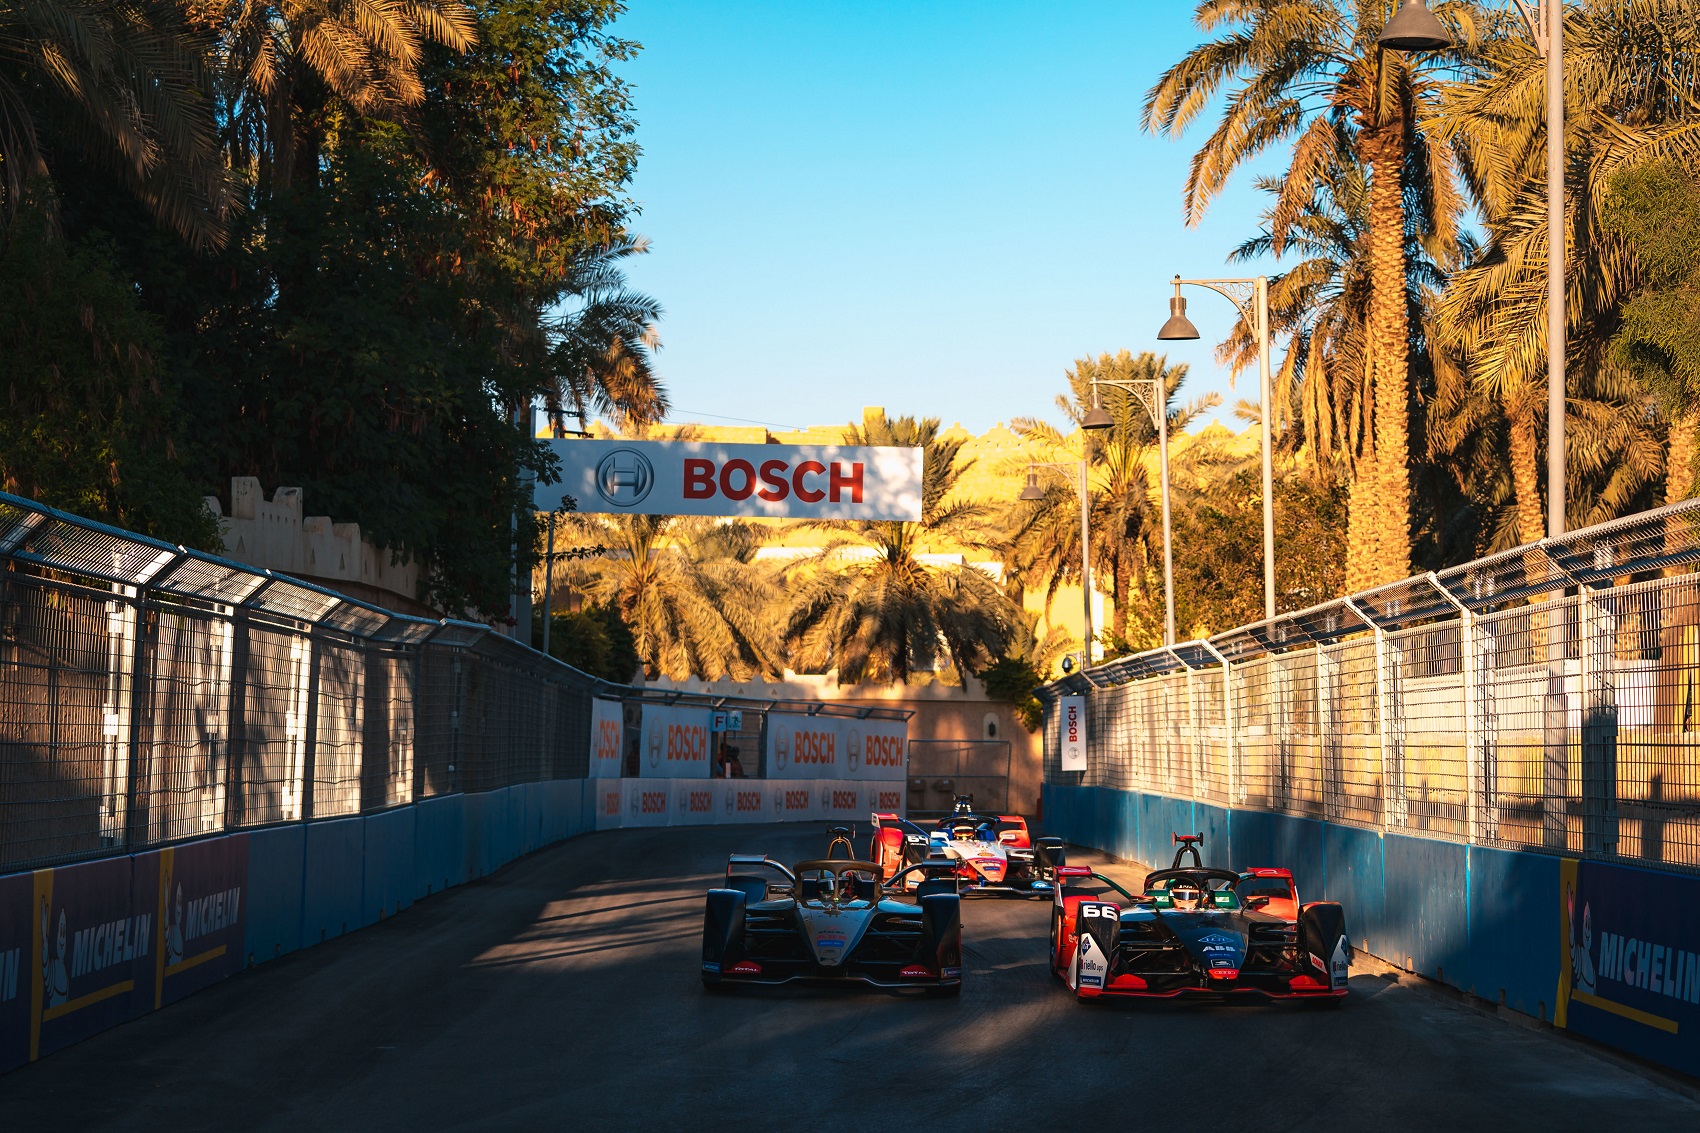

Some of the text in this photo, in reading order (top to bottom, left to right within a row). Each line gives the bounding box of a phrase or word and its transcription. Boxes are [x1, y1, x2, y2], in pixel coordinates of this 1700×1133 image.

[683, 458, 864, 504] BOSCH
[715, 716, 725, 728] F
[1068, 706, 1078, 742] BOSCH
[667, 724, 707, 761] BOSCH
[794, 731, 835, 764] BOSCH
[866, 735, 903, 766] BOSCH
[642, 792, 666, 814] BOSCH
[690, 791, 712, 812] BOSCH
[737, 791, 761, 812] BOSCH
[785, 790, 809, 810] BOSCH
[833, 790, 857, 809] BOSCH
[880, 791, 900, 809] BOSCH
[907, 835, 929, 845] 64
[185, 887, 240, 941] MICHELIN
[1083, 905, 1118, 921] 66
[71, 913, 151, 978] MICHELIN
[1599, 931, 1700, 1005] MICHELIN
